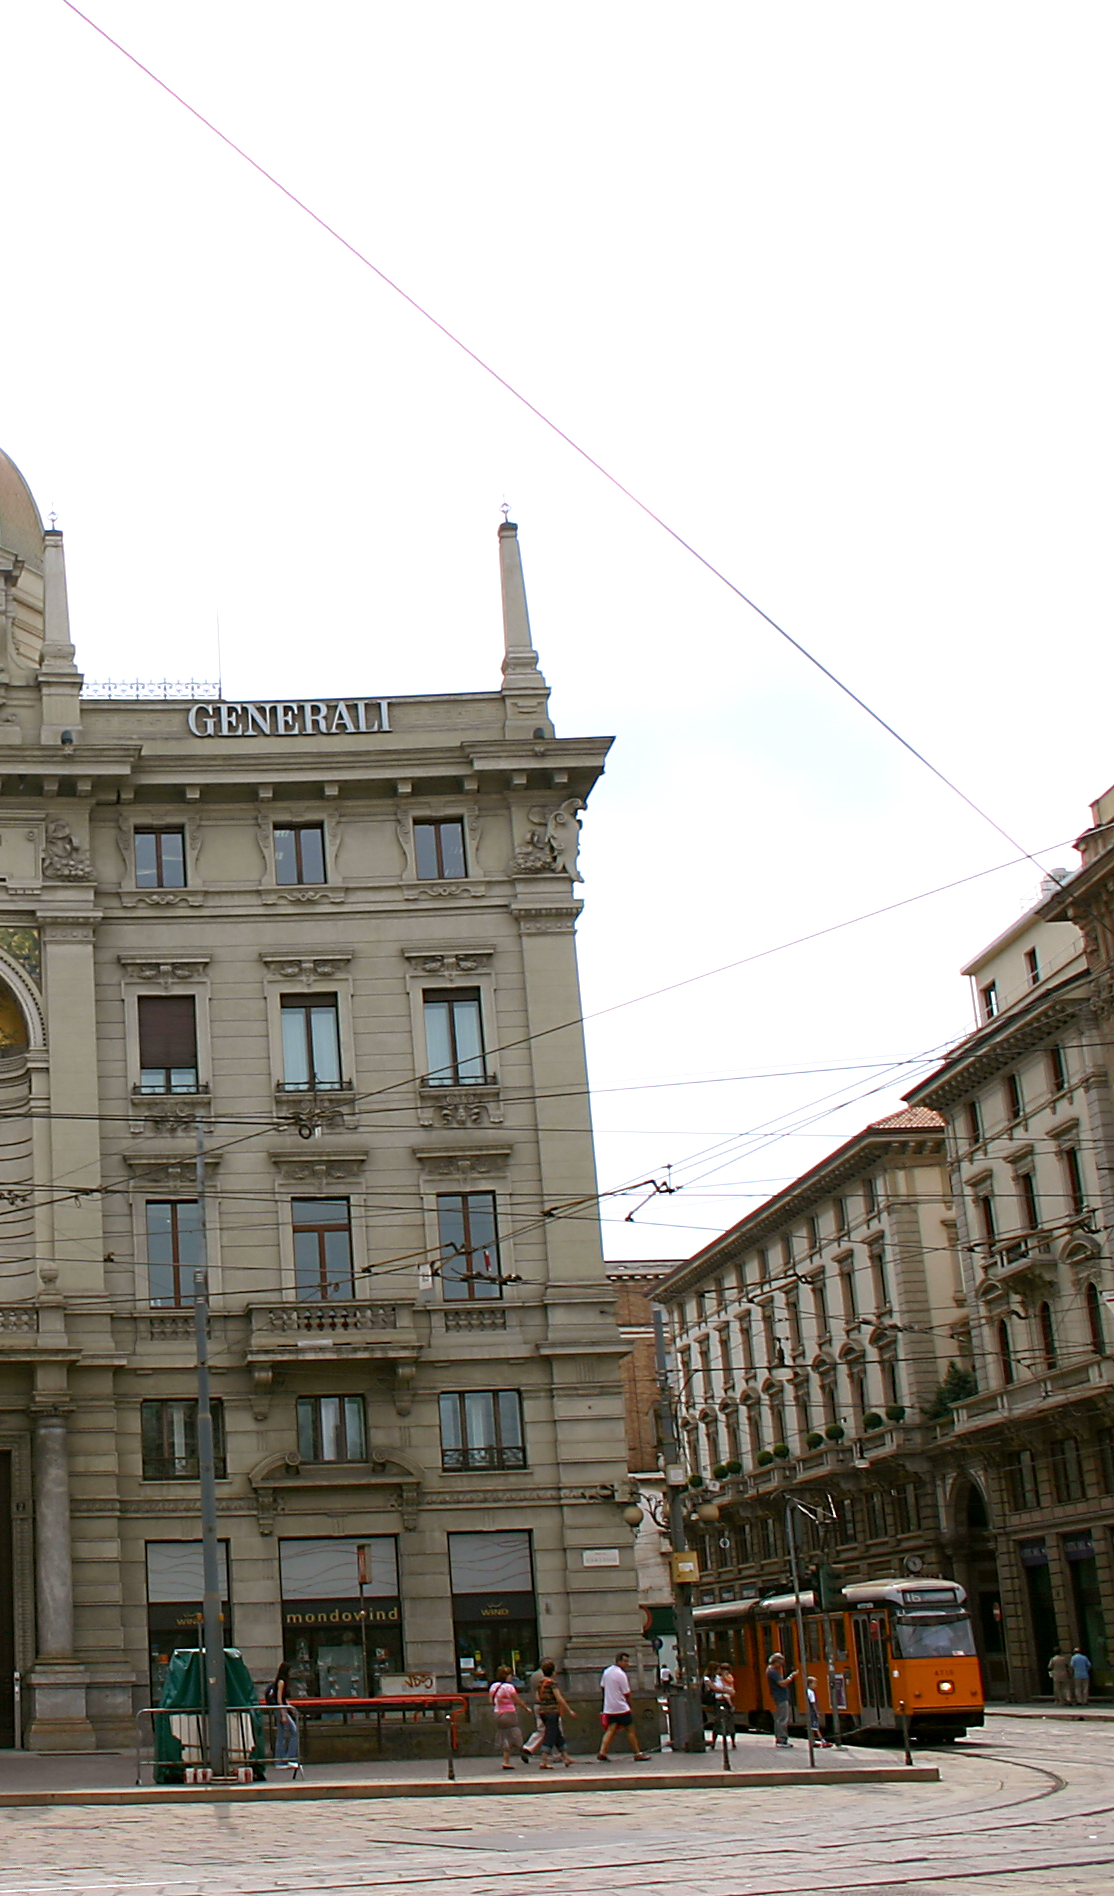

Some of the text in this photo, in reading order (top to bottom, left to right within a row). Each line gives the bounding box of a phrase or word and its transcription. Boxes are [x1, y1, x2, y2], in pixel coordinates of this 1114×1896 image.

[187, 699, 394, 738] GENERALI
[906, 1593, 921, 1602] 16
[286, 1607, 398, 1623] mondowind
